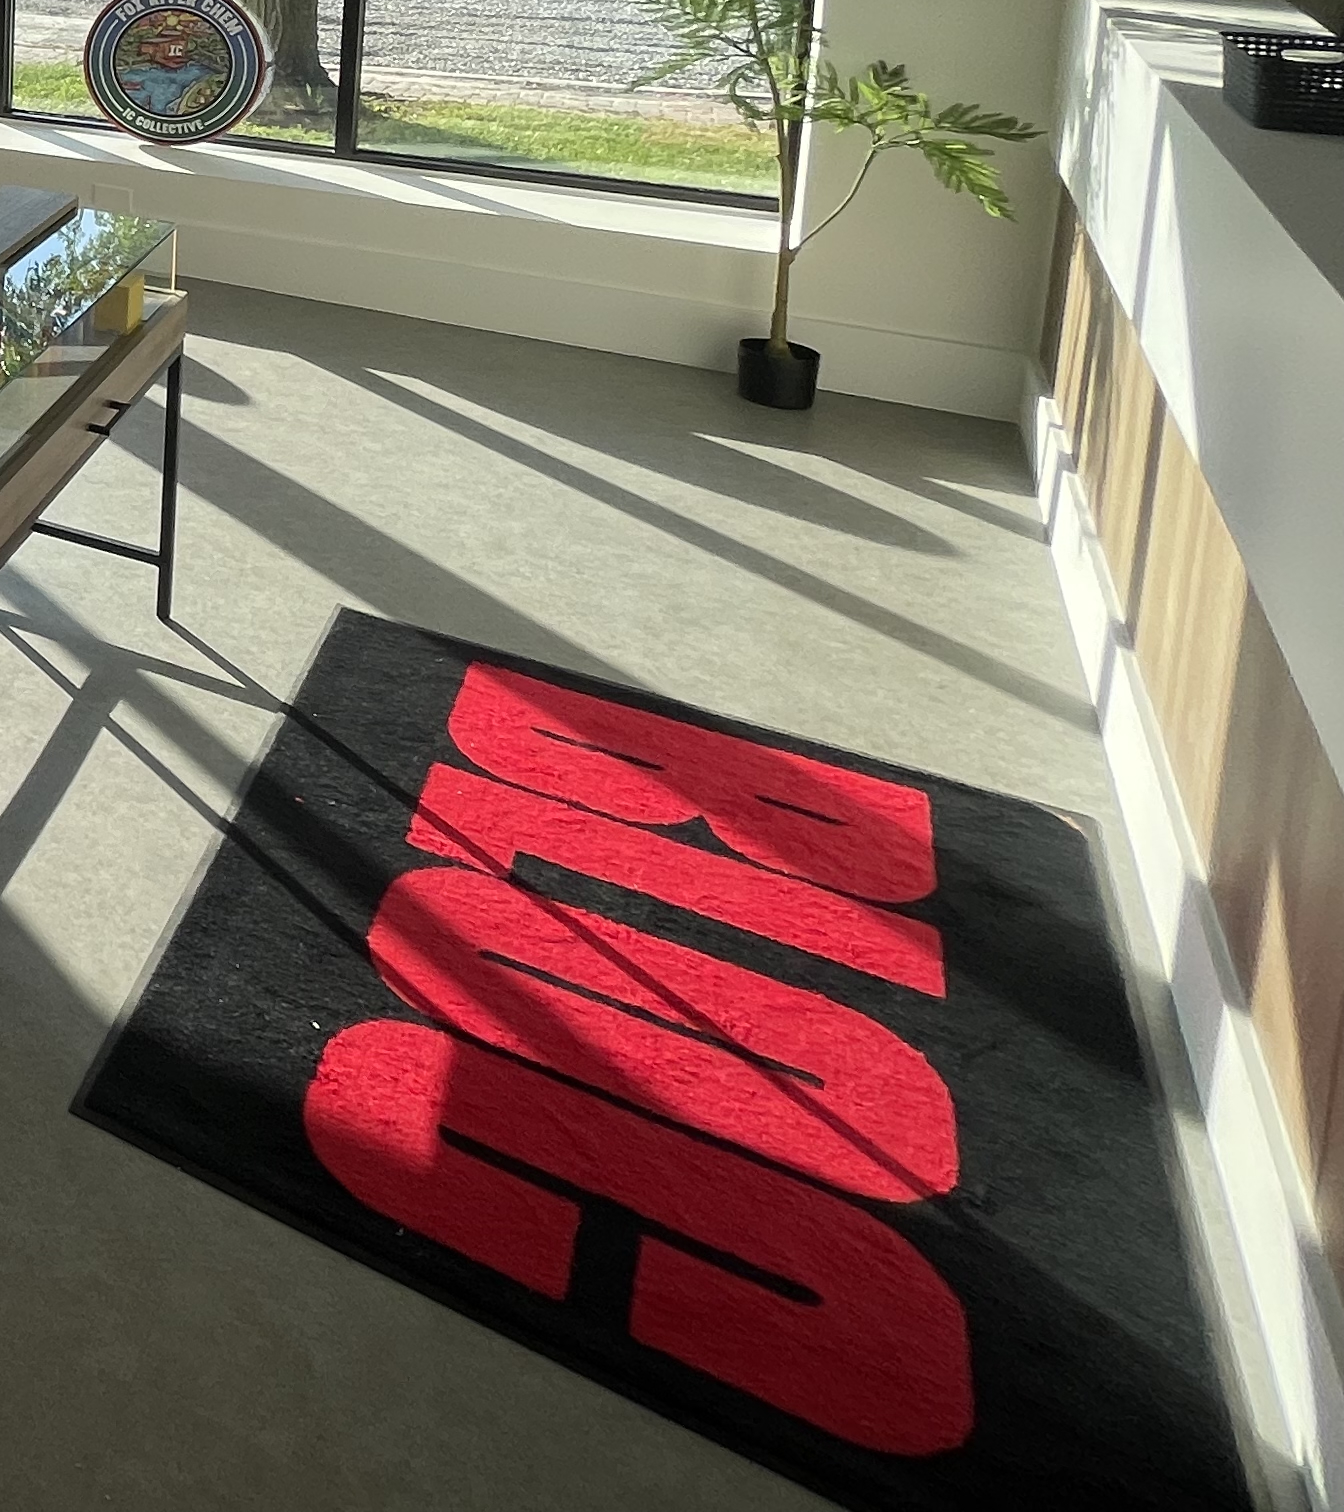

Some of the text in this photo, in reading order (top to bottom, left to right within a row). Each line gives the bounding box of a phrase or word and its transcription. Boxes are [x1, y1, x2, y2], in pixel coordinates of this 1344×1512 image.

[121, 107, 205, 136] IC COLLECTIVE
[305, 662, 975, 1460] BLOC
